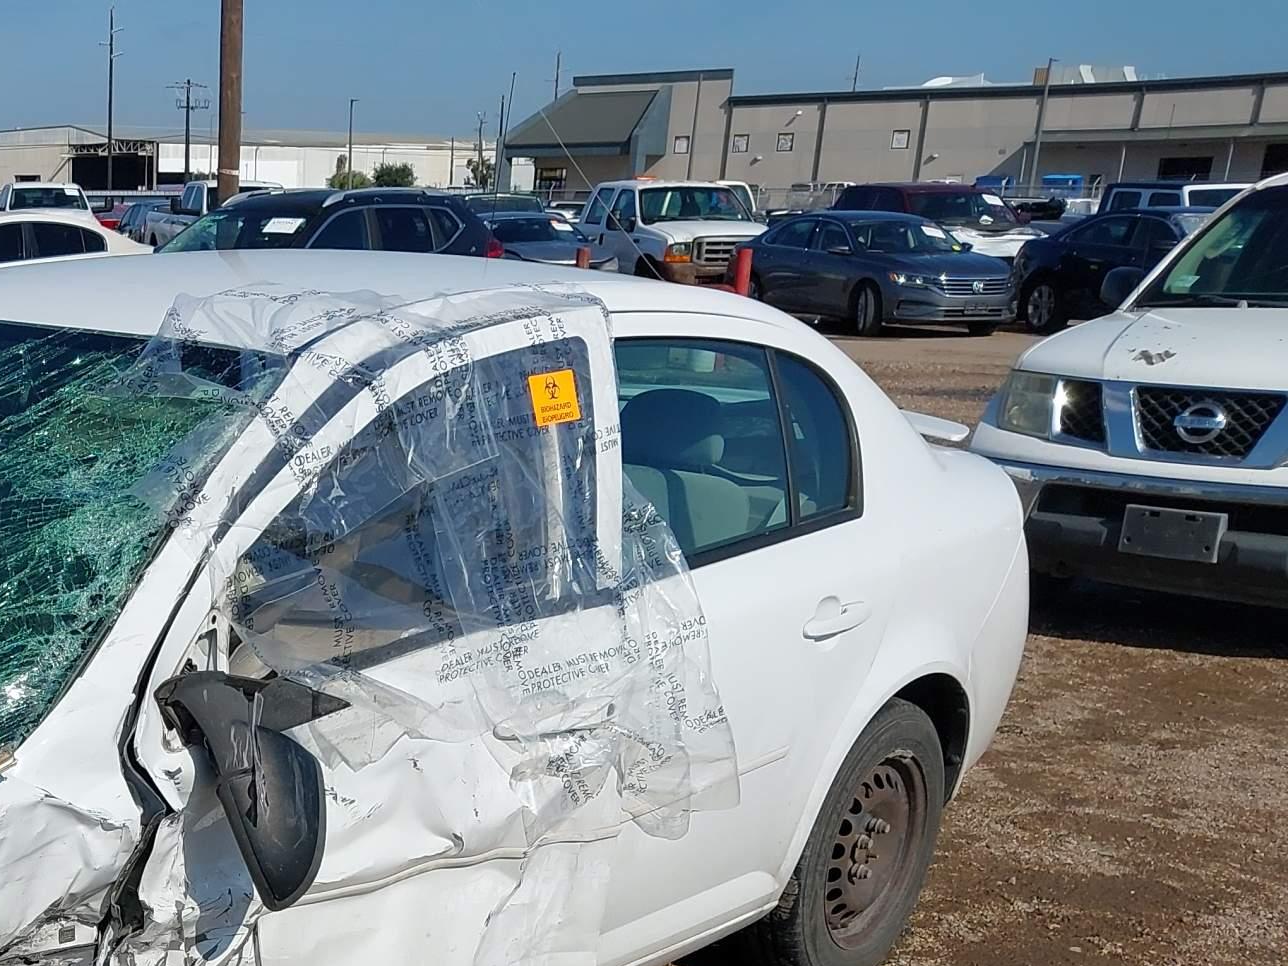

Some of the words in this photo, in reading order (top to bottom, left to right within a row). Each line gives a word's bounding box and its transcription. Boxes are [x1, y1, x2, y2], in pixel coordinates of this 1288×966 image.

[541, 401, 572, 413] BIOHAZARD
[438, 655, 494, 685] PROTECTIVE
[440, 650, 473, 673] DEALER
[526, 660, 563, 681] DEALER
[530, 670, 587, 694] PROTECTIVE
